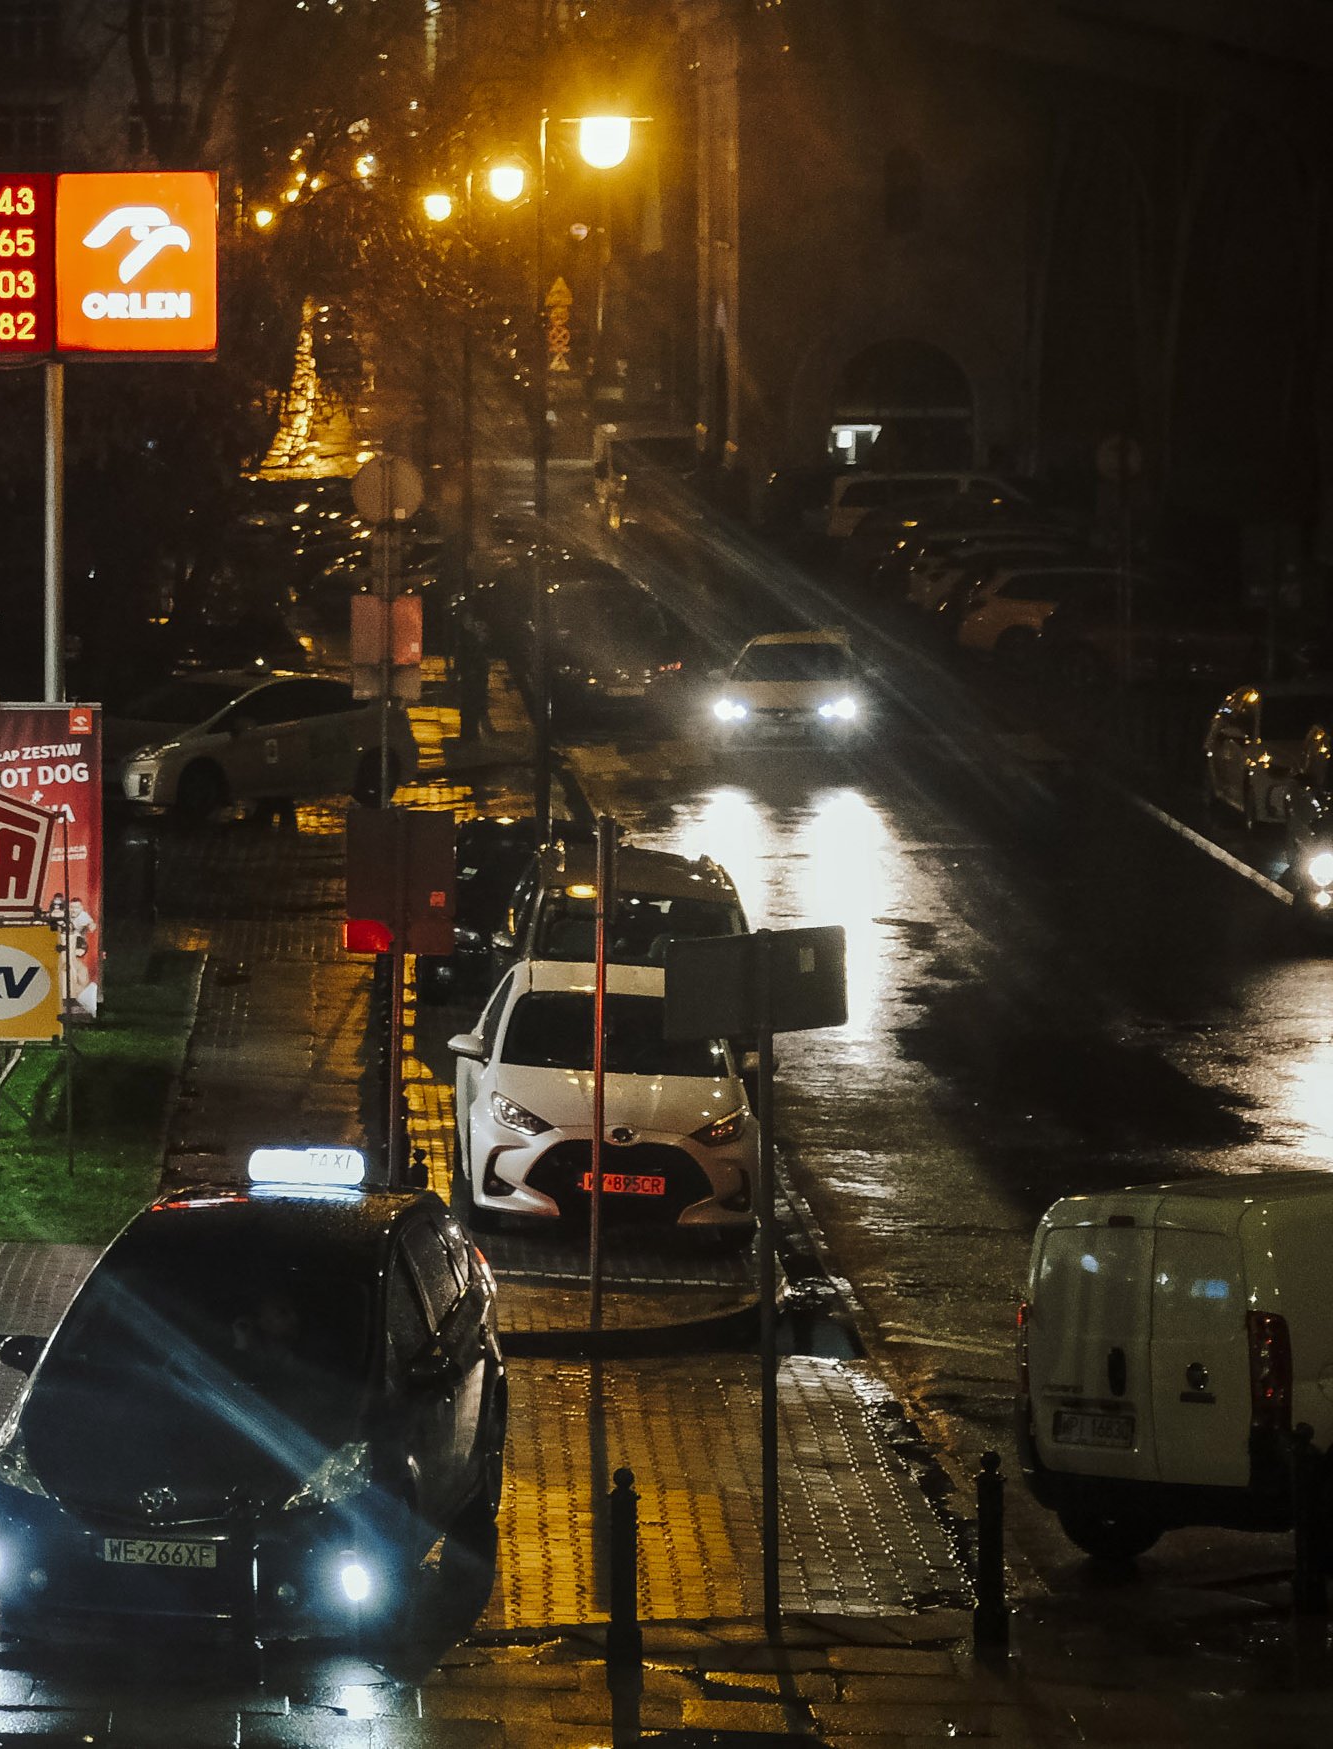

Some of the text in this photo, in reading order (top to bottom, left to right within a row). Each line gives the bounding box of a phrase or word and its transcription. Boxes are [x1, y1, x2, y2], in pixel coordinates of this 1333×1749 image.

[81, 293, 192, 320] ORLEN
[21, 743, 82, 760] ZESTAW
[37, 762, 90, 785] DOG
[310, 1153, 351, 1169] TAXI
[109, 1540, 213, 1567] WE 266XF
